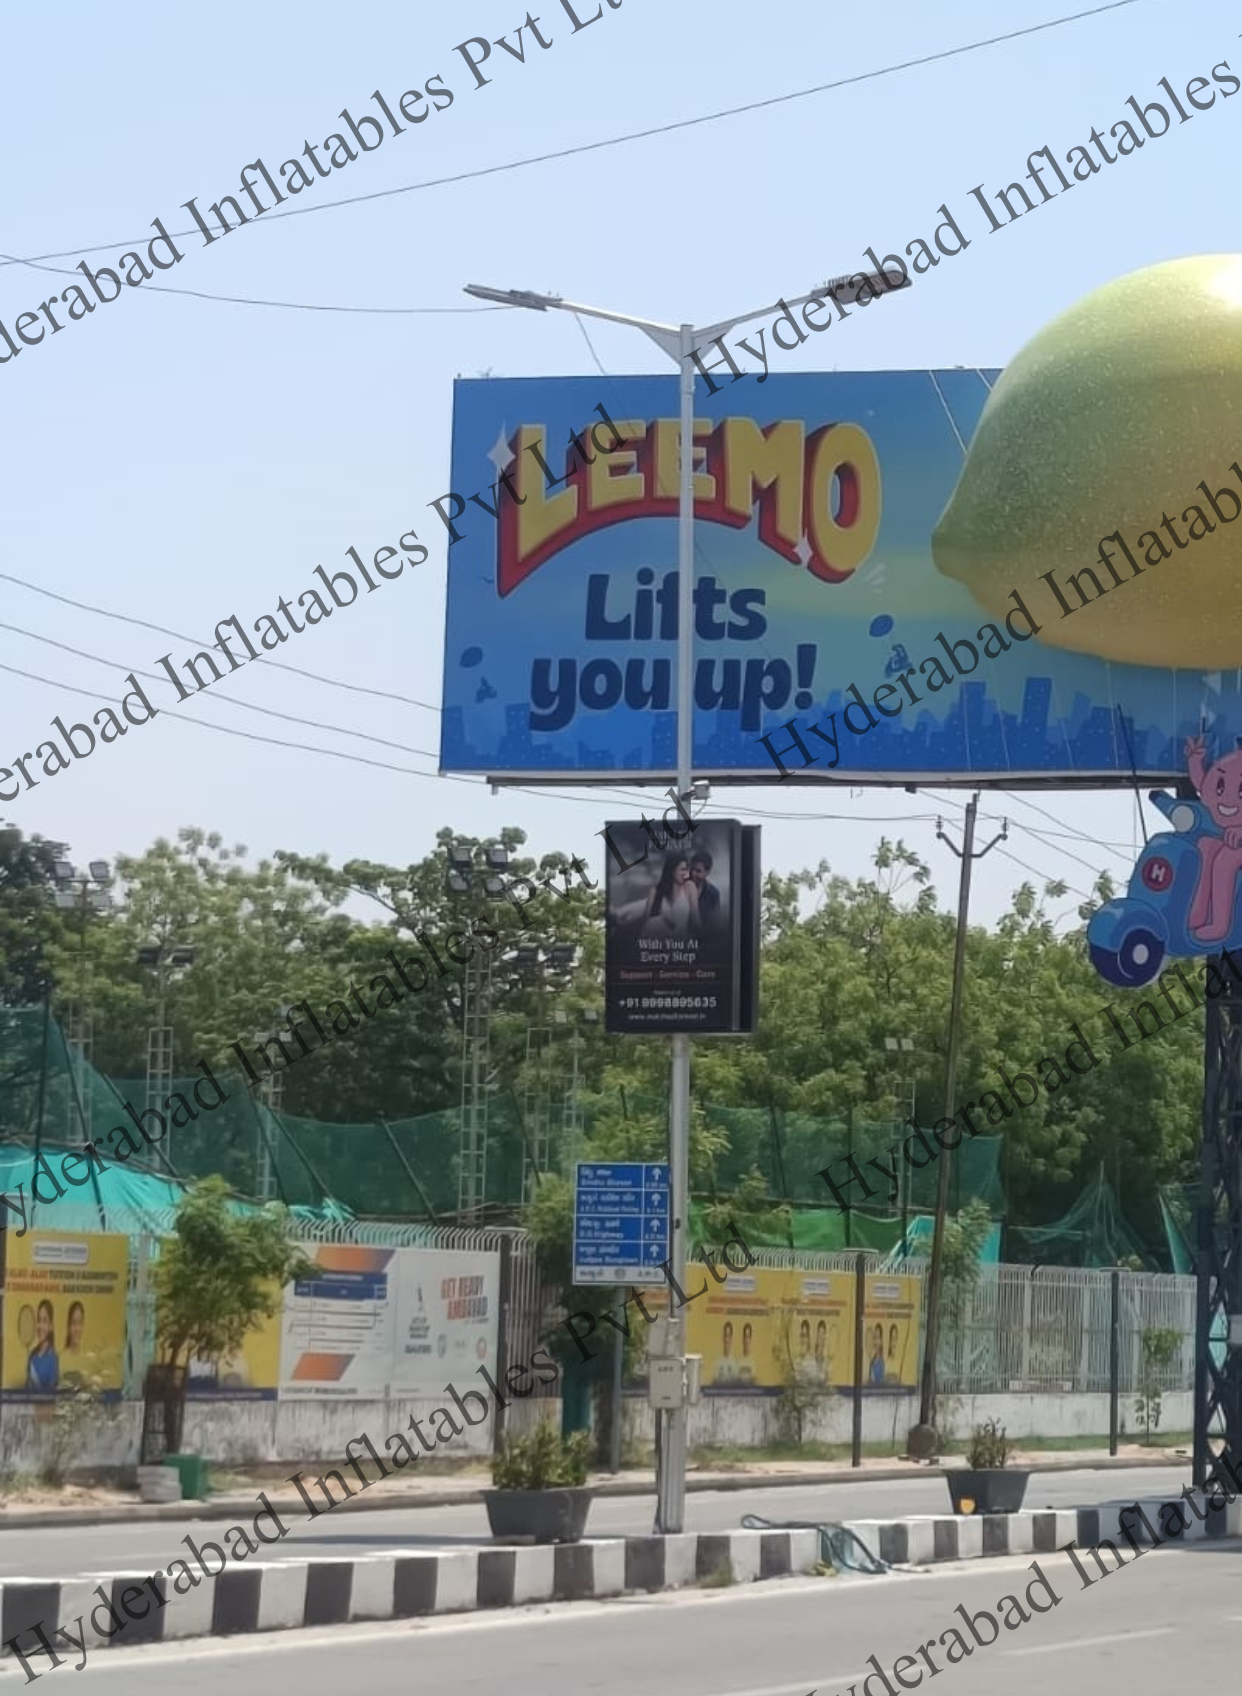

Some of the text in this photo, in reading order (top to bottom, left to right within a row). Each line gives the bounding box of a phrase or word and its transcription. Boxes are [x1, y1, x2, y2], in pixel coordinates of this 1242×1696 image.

[497, 415, 884, 598] LEEMO
[585, 567, 767, 641] Lifts
[529, 643, 817, 731] you up!
[1151, 863, 1166, 882] H
[640, 952, 696, 964] Every Step
[666, 939, 684, 949] You
